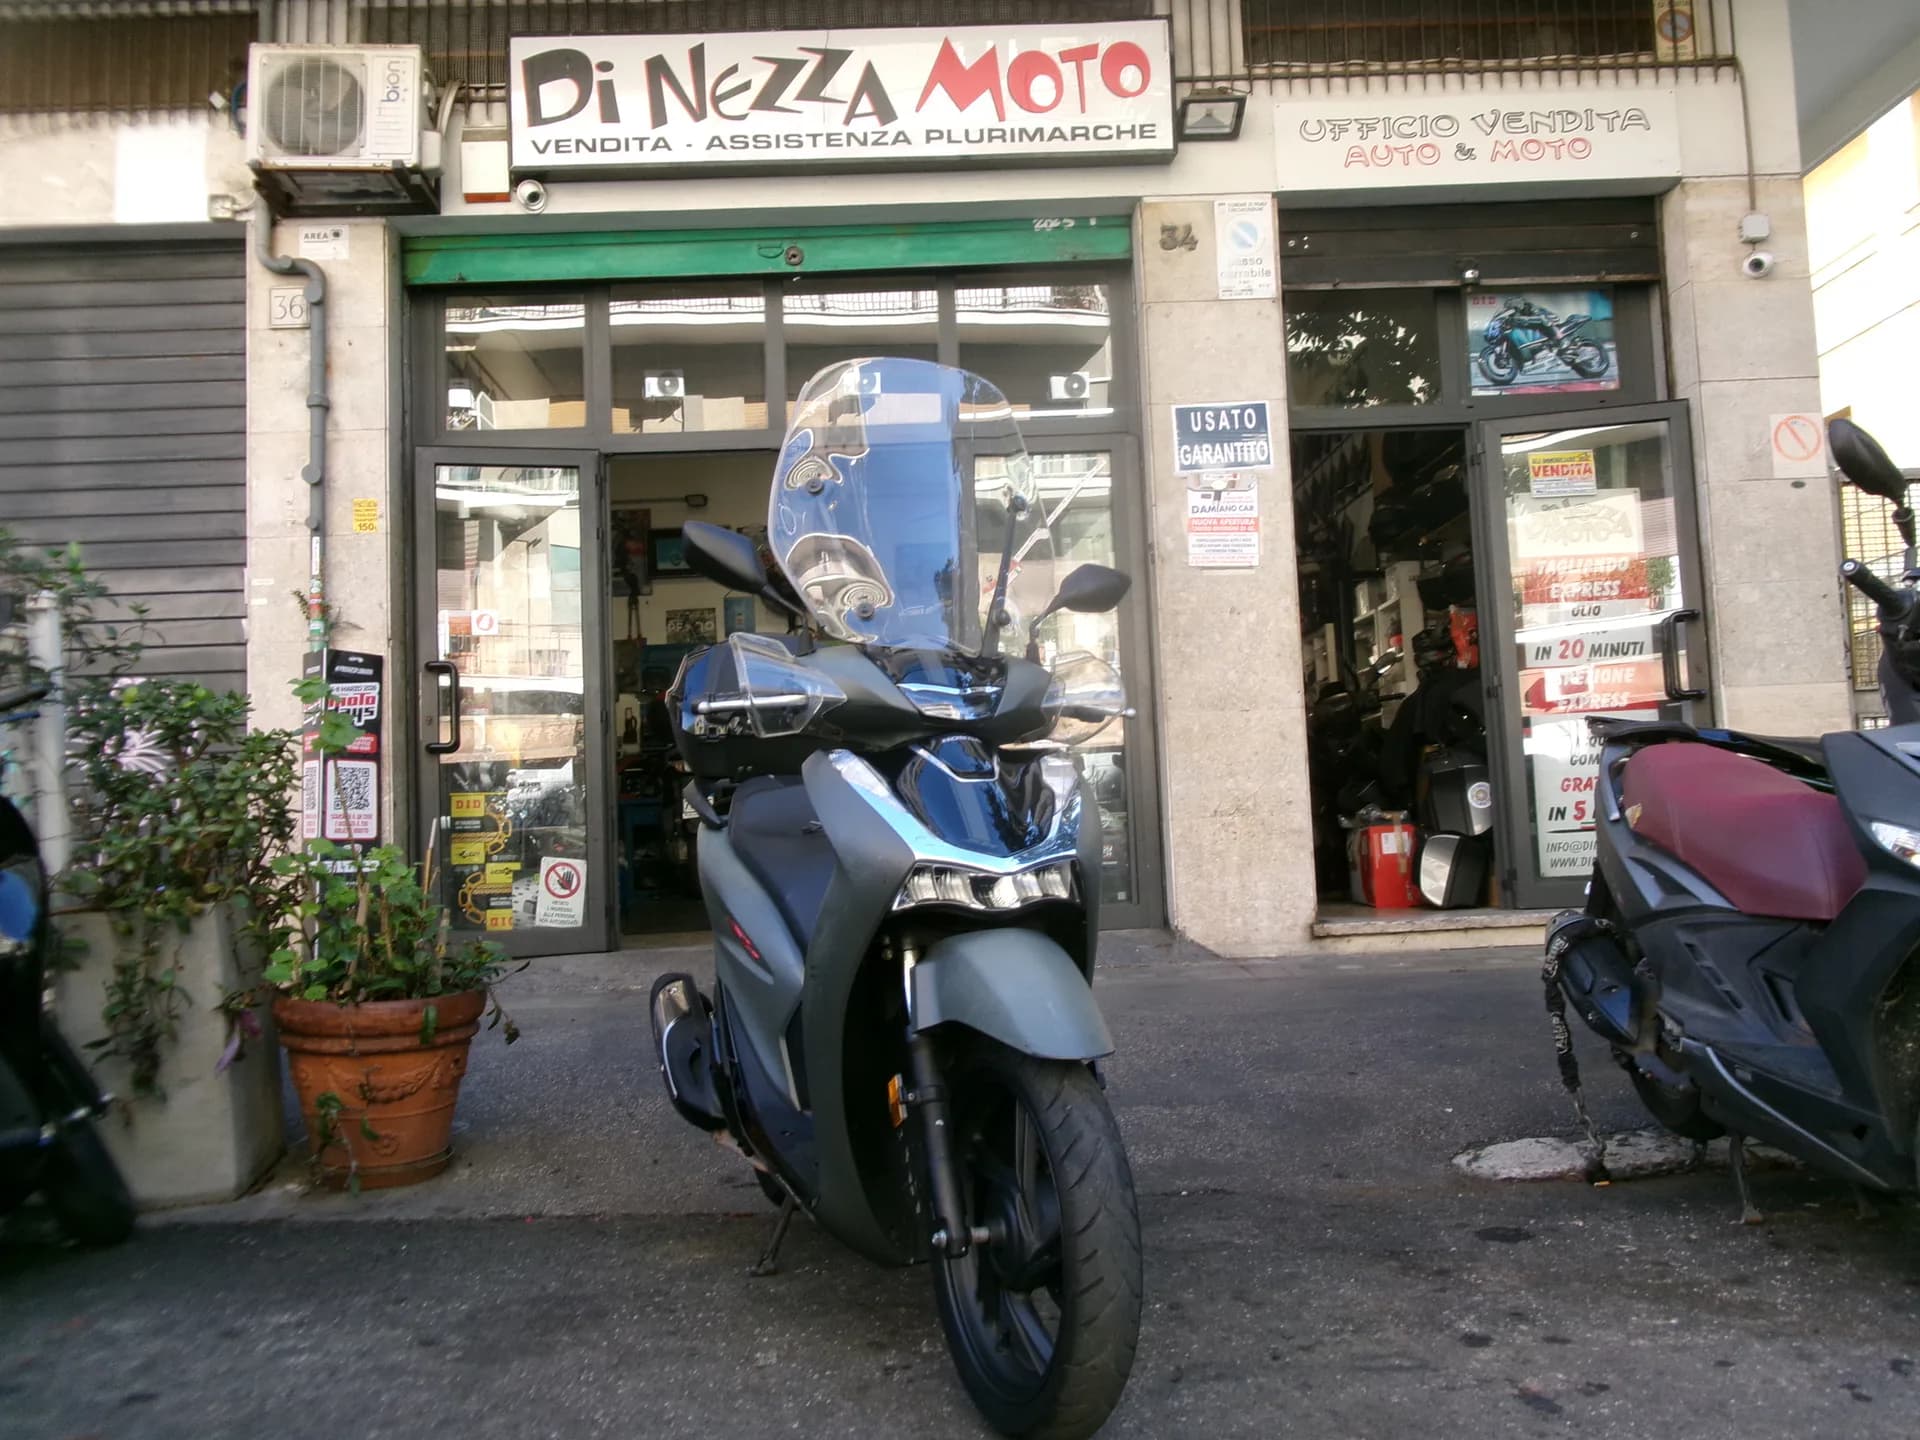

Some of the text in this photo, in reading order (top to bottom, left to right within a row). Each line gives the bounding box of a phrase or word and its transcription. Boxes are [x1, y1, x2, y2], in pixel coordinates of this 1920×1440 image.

[915, 35, 1152, 123] MOTO
[1299, 107, 1650, 143] UFFICIO VENDITA
[531, 136, 671, 154] VENDITA
[705, 129, 912, 151] ASSISTENZA
[925, 122, 1157, 145] PLURIMARCHE
[1345, 137, 1592, 168] AUTO & MOTO
[303, 232, 329, 240] AREA
[1160, 223, 1198, 251] 34
[273, 295, 305, 320] 36
[1190, 407, 1257, 433] USATO
[1179, 440, 1268, 466] GARANTITO
[1531, 462, 1593, 478] VENDITA
[1550, 580, 1622, 599] EXPRESS
[1571, 605, 1601, 617] OLIO
[1535, 639, 1645, 660] IN 20 MINUTI
[1570, 753, 1600, 766] COM
[455, 799, 481, 810] DID
[1548, 800, 1586, 821] IN 5
